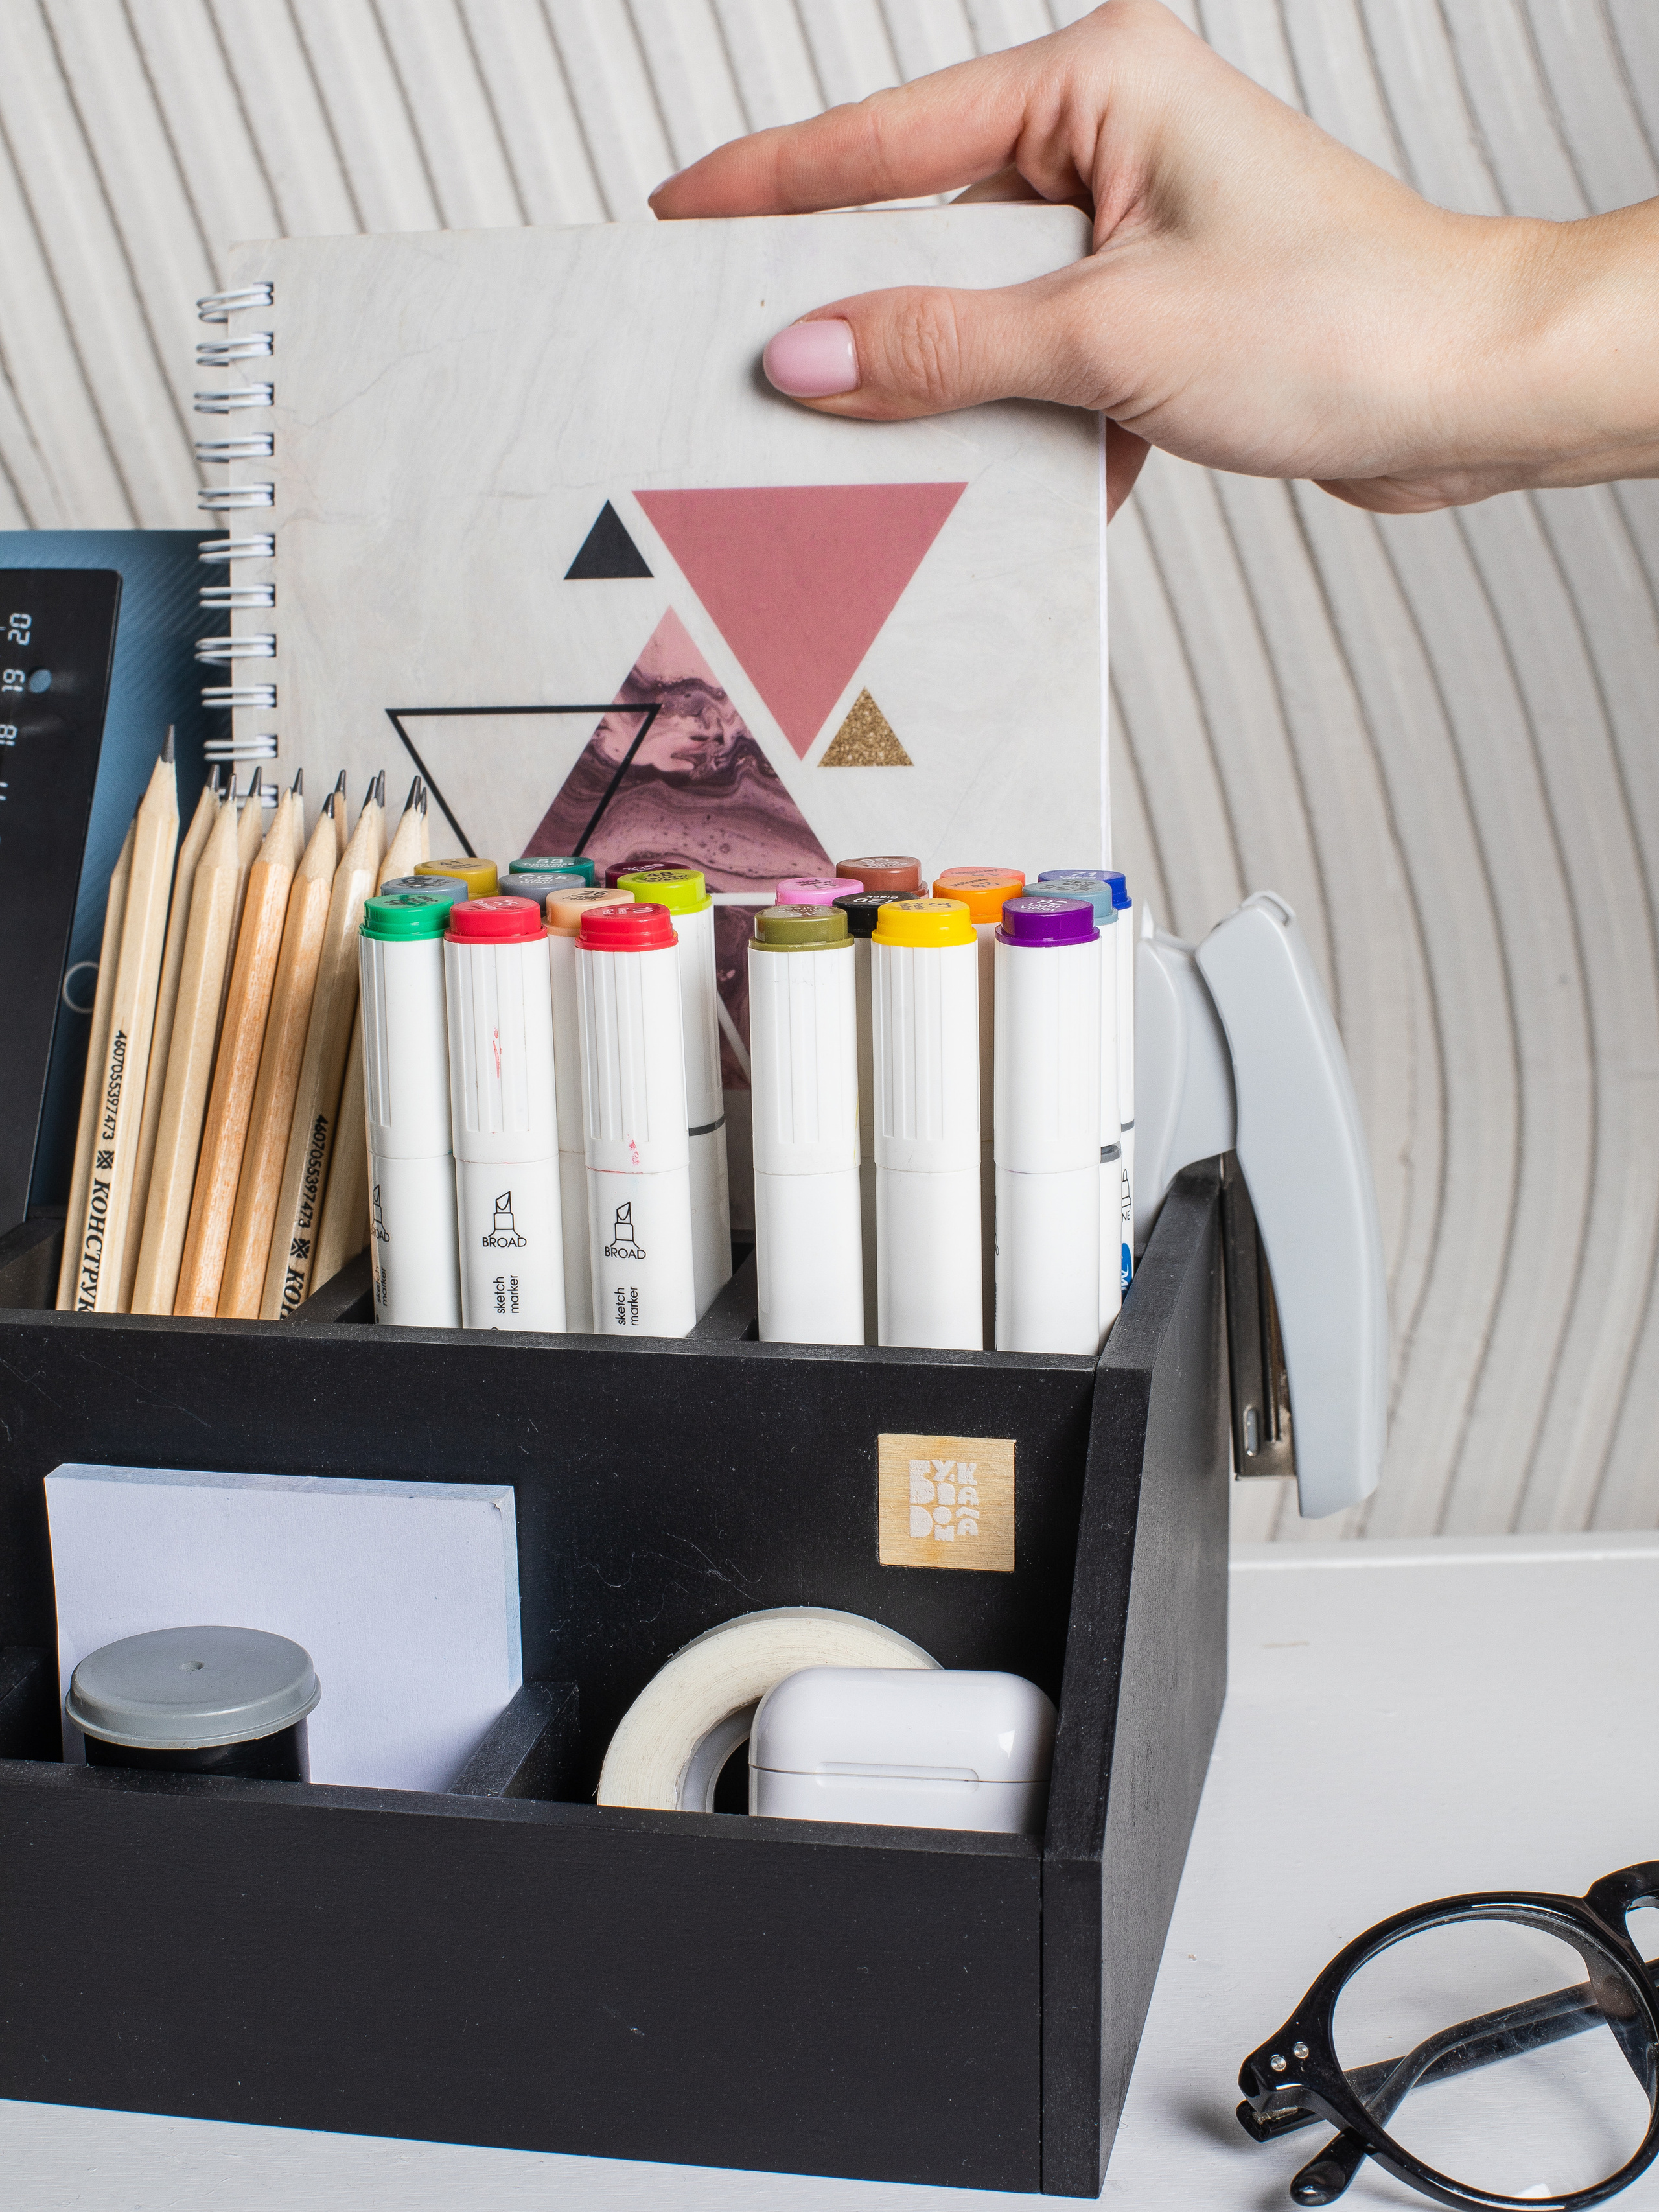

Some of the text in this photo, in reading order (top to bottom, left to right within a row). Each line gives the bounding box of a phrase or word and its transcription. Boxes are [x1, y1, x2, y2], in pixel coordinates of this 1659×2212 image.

[8, 612, 32, 645] 20
[1, 669, 25, 692] 19
[102, 1030, 128, 1141] 4607055397473
[297, 1114, 329, 1228] 4607055397473
[482, 1237, 528, 1248] BROAD
[605, 1246, 647, 1259] BROAD
[493, 1276, 505, 1314] sketch
[507, 1274, 520, 1314] marker
[614, 1286, 626, 1325] sketch
[627, 1286, 639, 1326] marker
